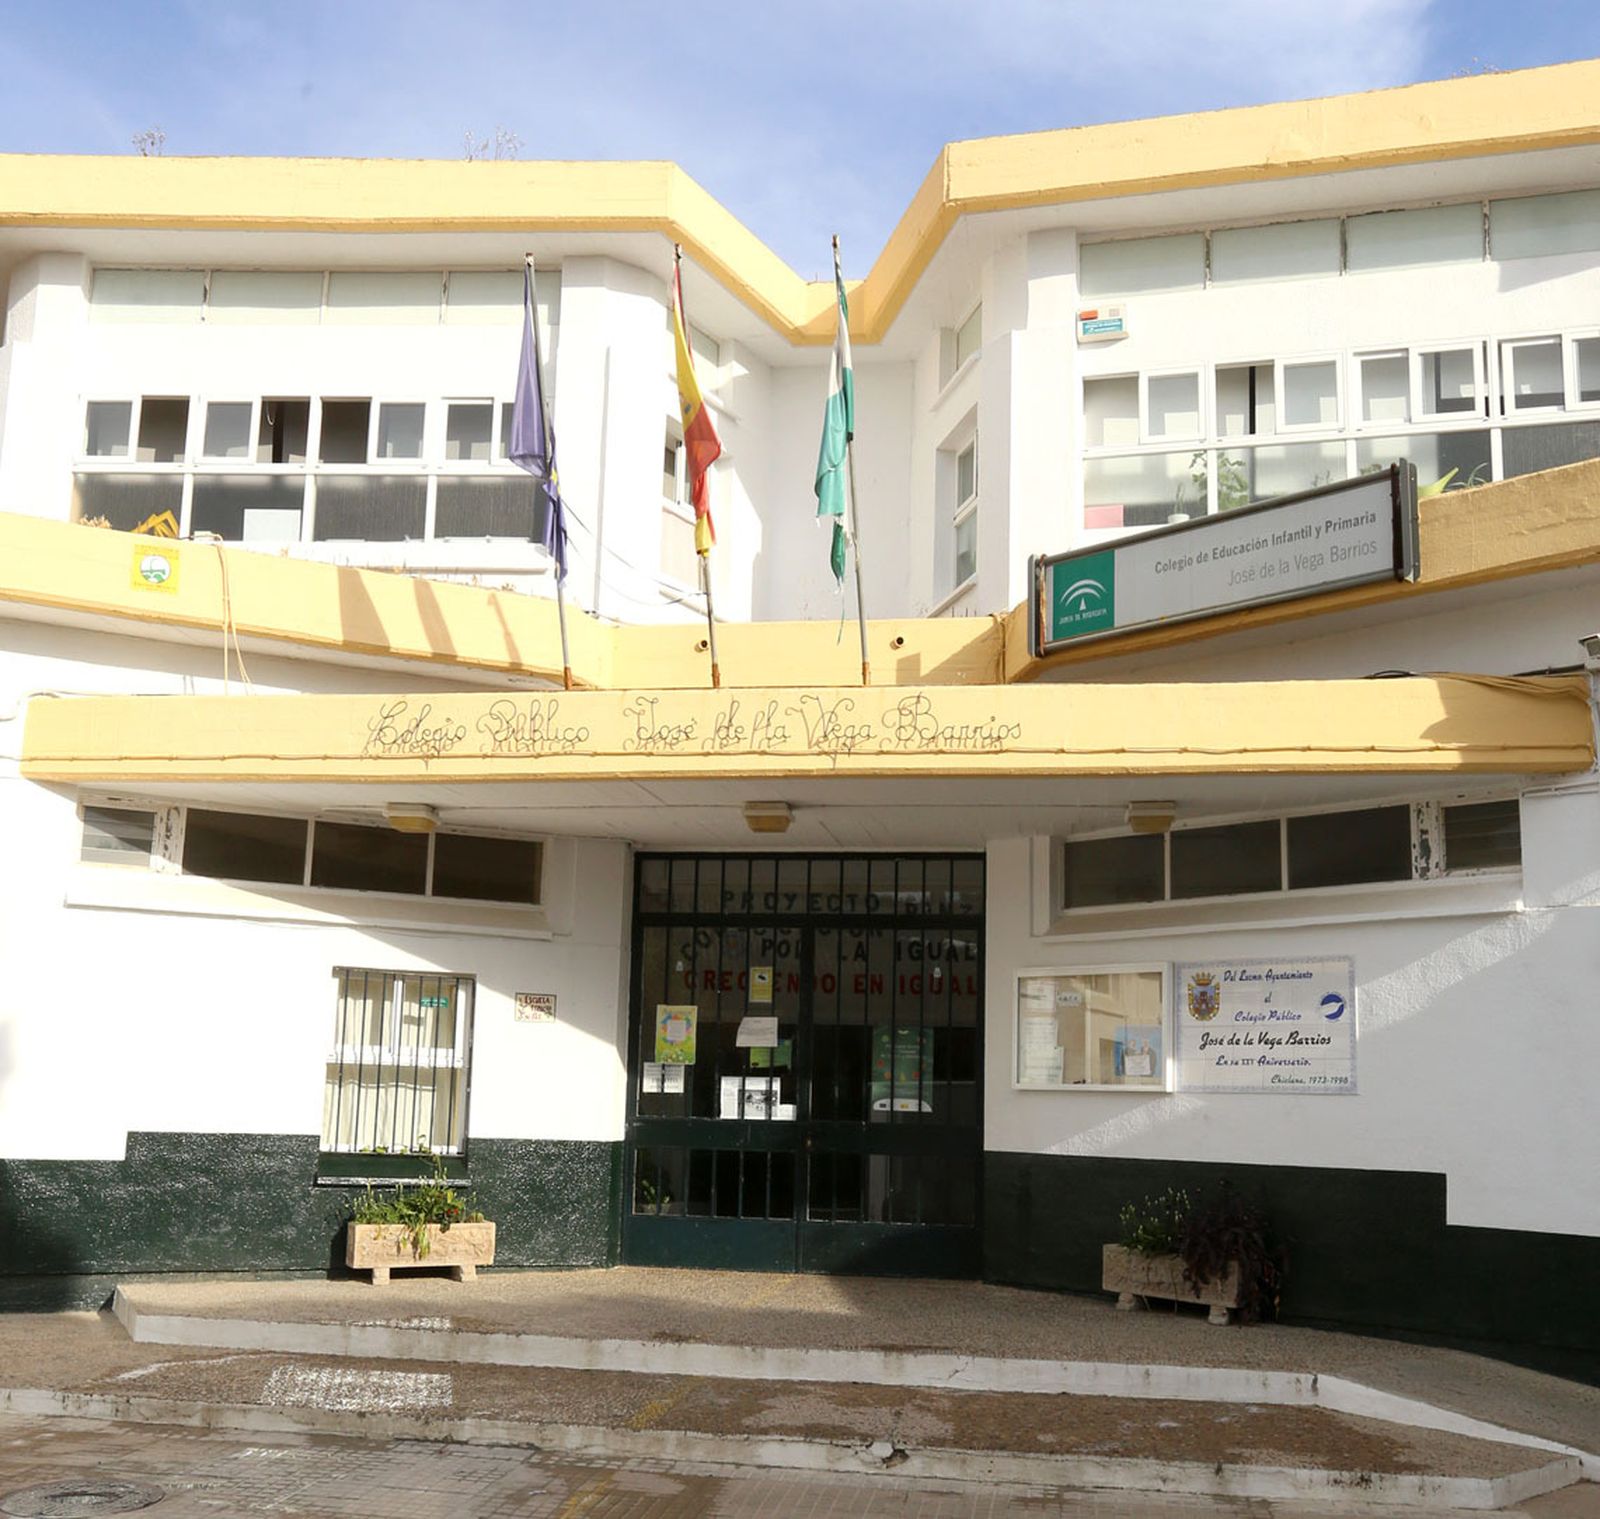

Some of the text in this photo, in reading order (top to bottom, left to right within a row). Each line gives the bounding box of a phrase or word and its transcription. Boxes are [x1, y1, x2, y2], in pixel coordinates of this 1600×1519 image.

[1155, 511, 1376, 573] Colegio de Educación Infantil y Primaria
[1228, 540, 1377, 586] José de la Vega Barrios
[375, 700, 467, 756] Colegio
[717, 699, 747, 740] de
[766, 699, 794, 740] la
[800, 695, 878, 757] Vega
[894, 691, 1022, 742] Barrios
[723, 891, 881, 912] PROYECTO
[838, 941, 868, 962] A
[684, 970, 836, 994] CRECENO
[853, 974, 883, 995] EN
[1224, 970, 1235, 981] Del
[1265, 969, 1313, 982] Ayuntamiento
[1234, 1011, 1266, 1024] Colegio
[1199, 1031, 1331, 1050] José de la Vega Barrios
[1216, 1055, 1228, 1066] En
